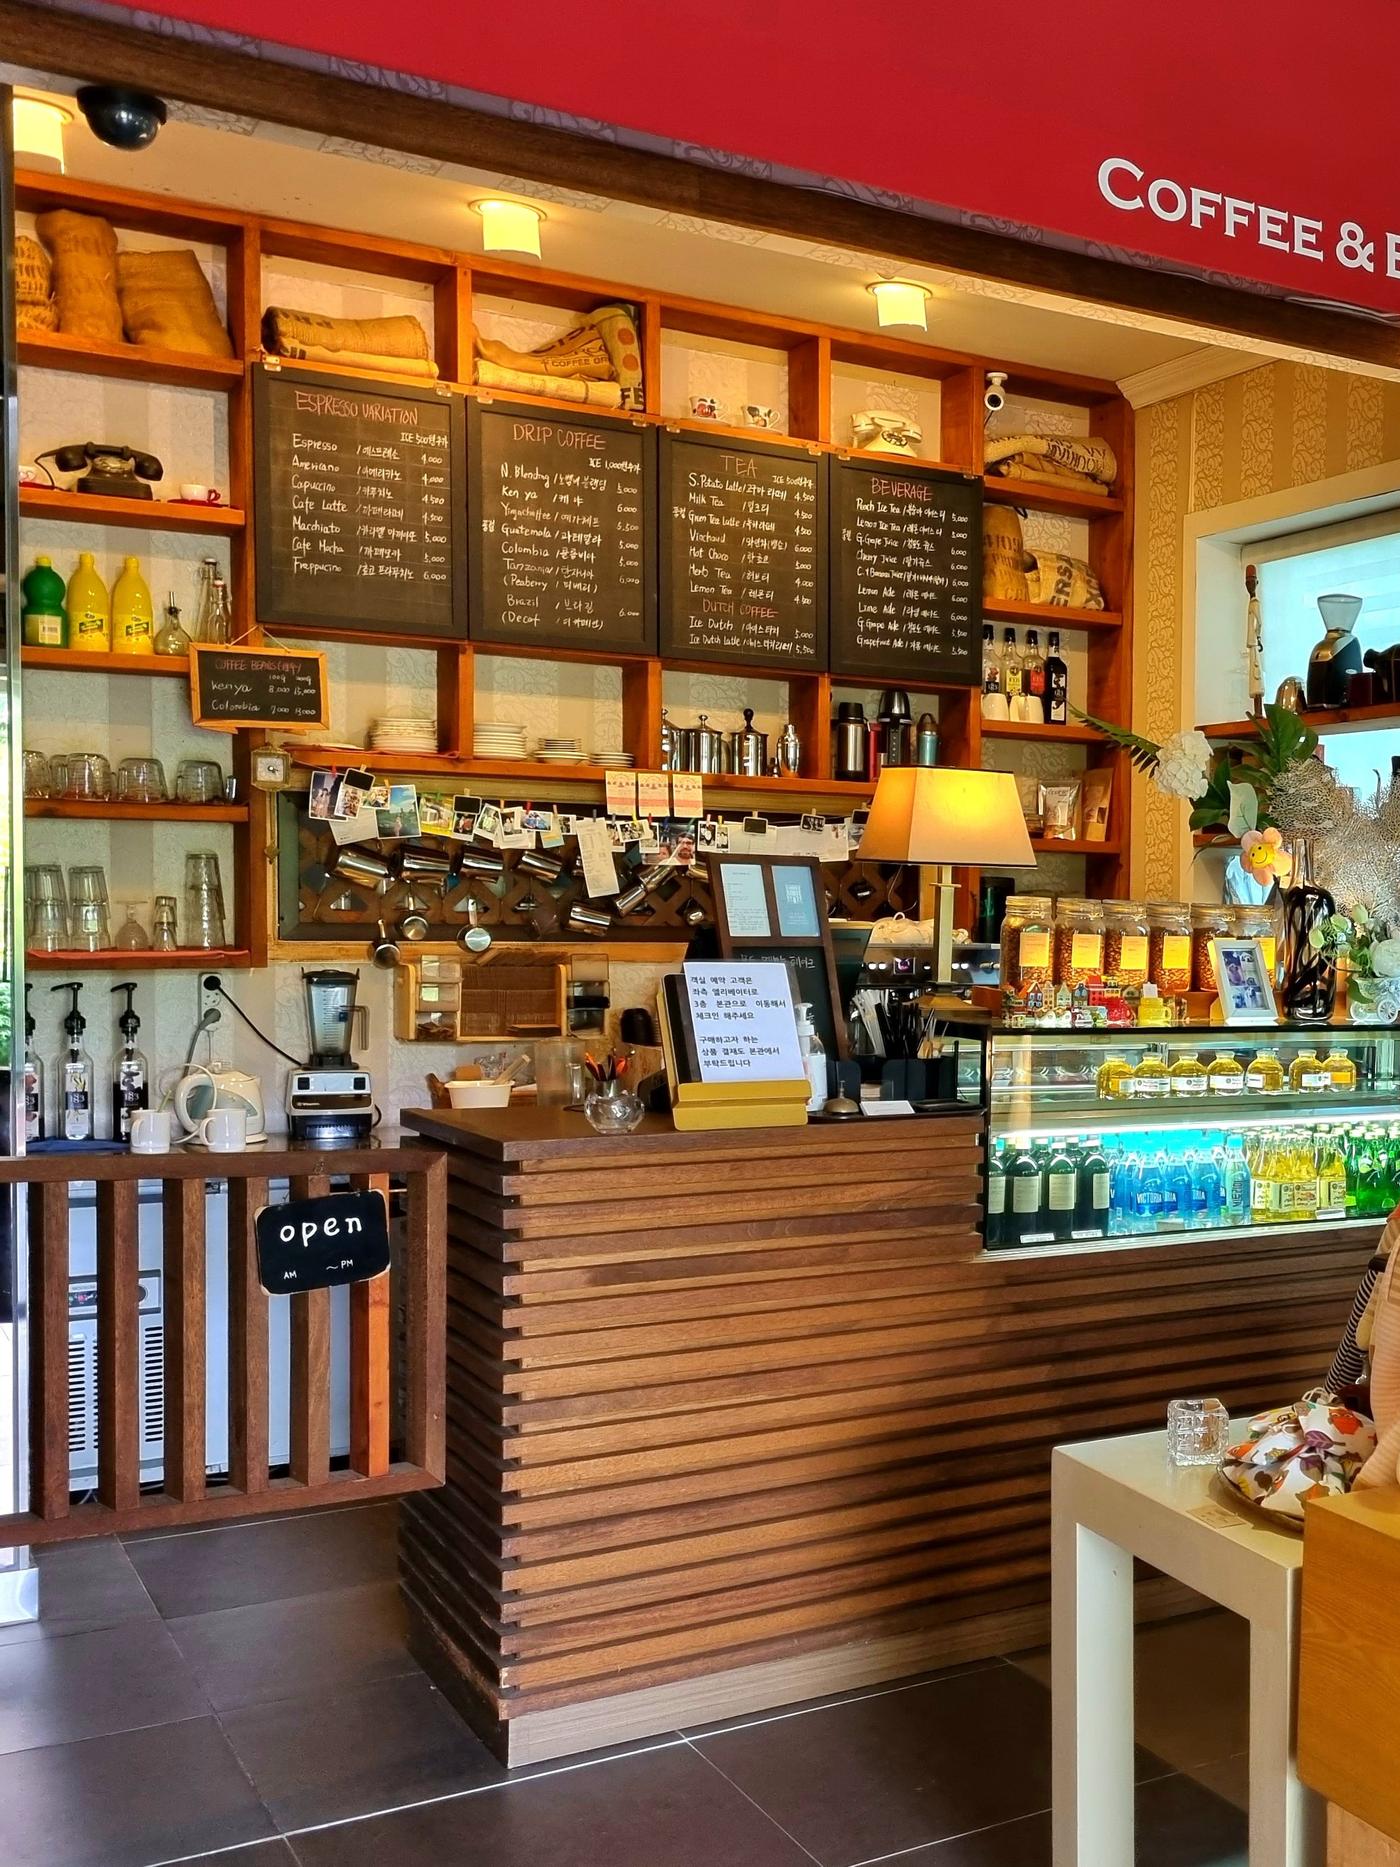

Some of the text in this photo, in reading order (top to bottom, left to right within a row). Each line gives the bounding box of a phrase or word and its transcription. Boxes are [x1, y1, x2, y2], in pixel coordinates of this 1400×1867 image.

[1098, 157, 1324, 262] COFFEE
[1335, 221, 1374, 273] &
[295, 391, 418, 425] ESPRESSO VARIATION
[293, 433, 337, 452] Espresso
[513, 424, 607, 449] DRIP COFFEE
[292, 454, 340, 472] Americano
[720, 455, 758, 478] TEA
[291, 474, 335, 493] Capuccino
[515, 465, 549, 488] Blending
[871, 477, 933, 501] BEVERAGE
[293, 495, 314, 515] Cafe
[322, 500, 348, 512] Latte
[689, 493, 725, 506] Milk Tea
[877, 502, 887, 512] Ice
[889, 503, 900, 513] Tea
[293, 516, 340, 534] Macchiato
[293, 536, 311, 556] Cafe
[502, 542, 550, 557] Colombia
[689, 547, 728, 561] Hot Choco
[689, 563, 731, 579] Herb Tea
[690, 580, 732, 594] Lemon Tea
[507, 594, 539, 607] Brazil
[703, 598, 779, 618] DUTCH COFFEE
[689, 616, 733, 630] Ice Dutch
[689, 634, 700, 644] Ice
[702, 635, 721, 644] Dutch
[211, 700, 260, 711] Colombia
[691, 976, 706, 984] 객실
[716, 1000, 746, 1008] 본관으로
[755, 1000, 786, 1008] 이동해서
[696, 1012, 755, 1020] 체크인 해주세요
[700, 1036, 738, 1044] 구매하고자
[702, 1048, 717, 1056] 상품
[749, 1047, 780, 1055] 본관에서
[704, 1059, 751, 1067] 부탁드립니다
[280, 1217, 362, 1248] open
[283, 1259, 353, 1280] AM PM
